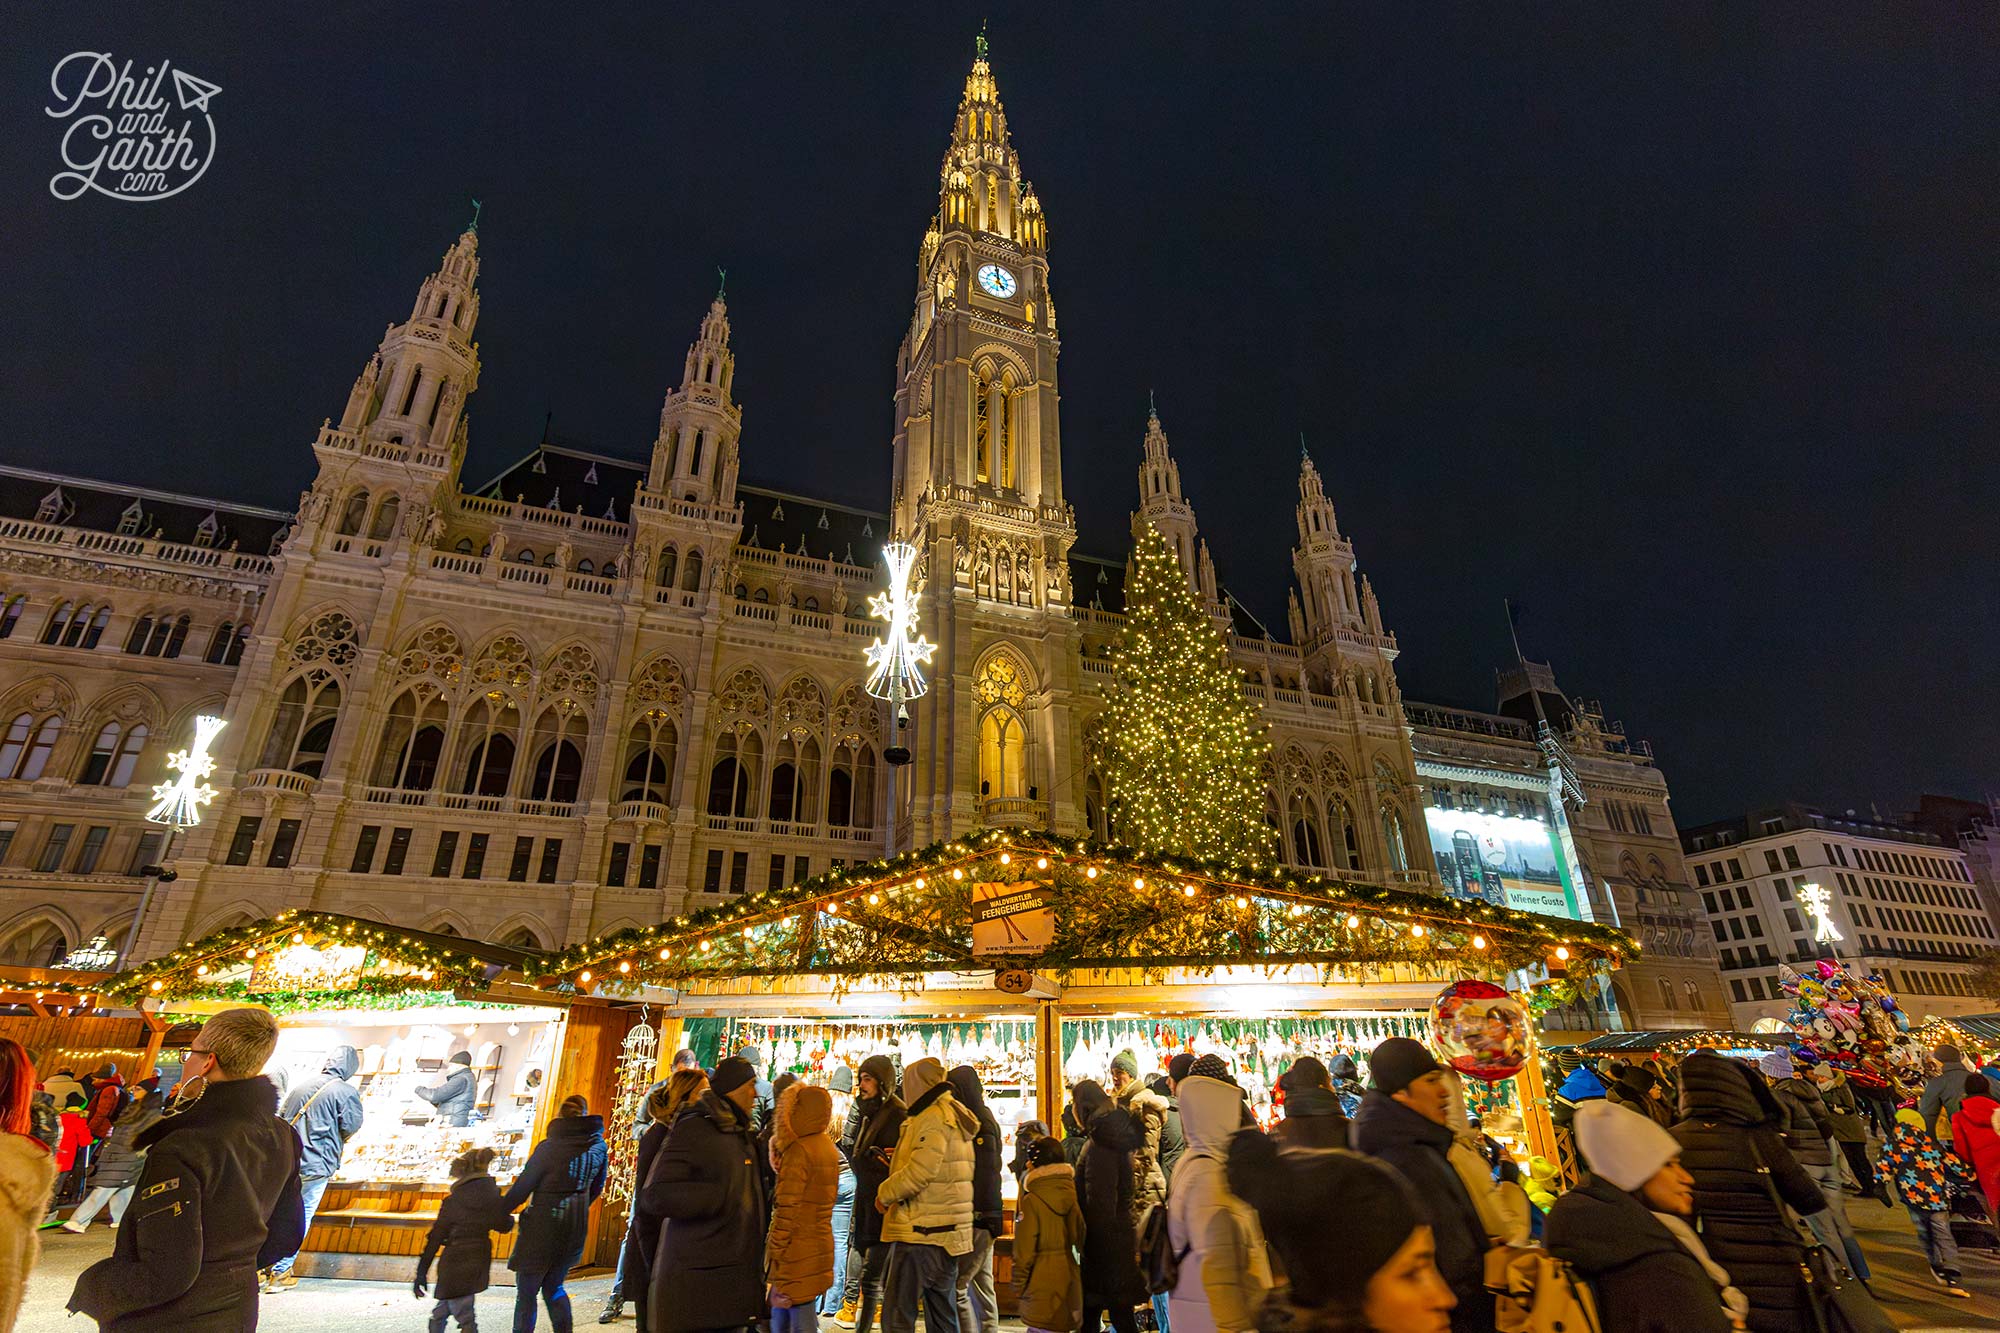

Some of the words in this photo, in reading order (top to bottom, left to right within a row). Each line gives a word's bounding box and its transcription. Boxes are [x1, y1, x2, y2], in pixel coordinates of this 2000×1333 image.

[989, 893, 1032, 908] WALDVIERTLER
[1510, 893, 1540, 905] Wiener
[1541, 895, 1565, 906] Gusto
[981, 897, 1043, 919] FEENGEHEIMNIS
[1005, 973, 1023, 988] 54
